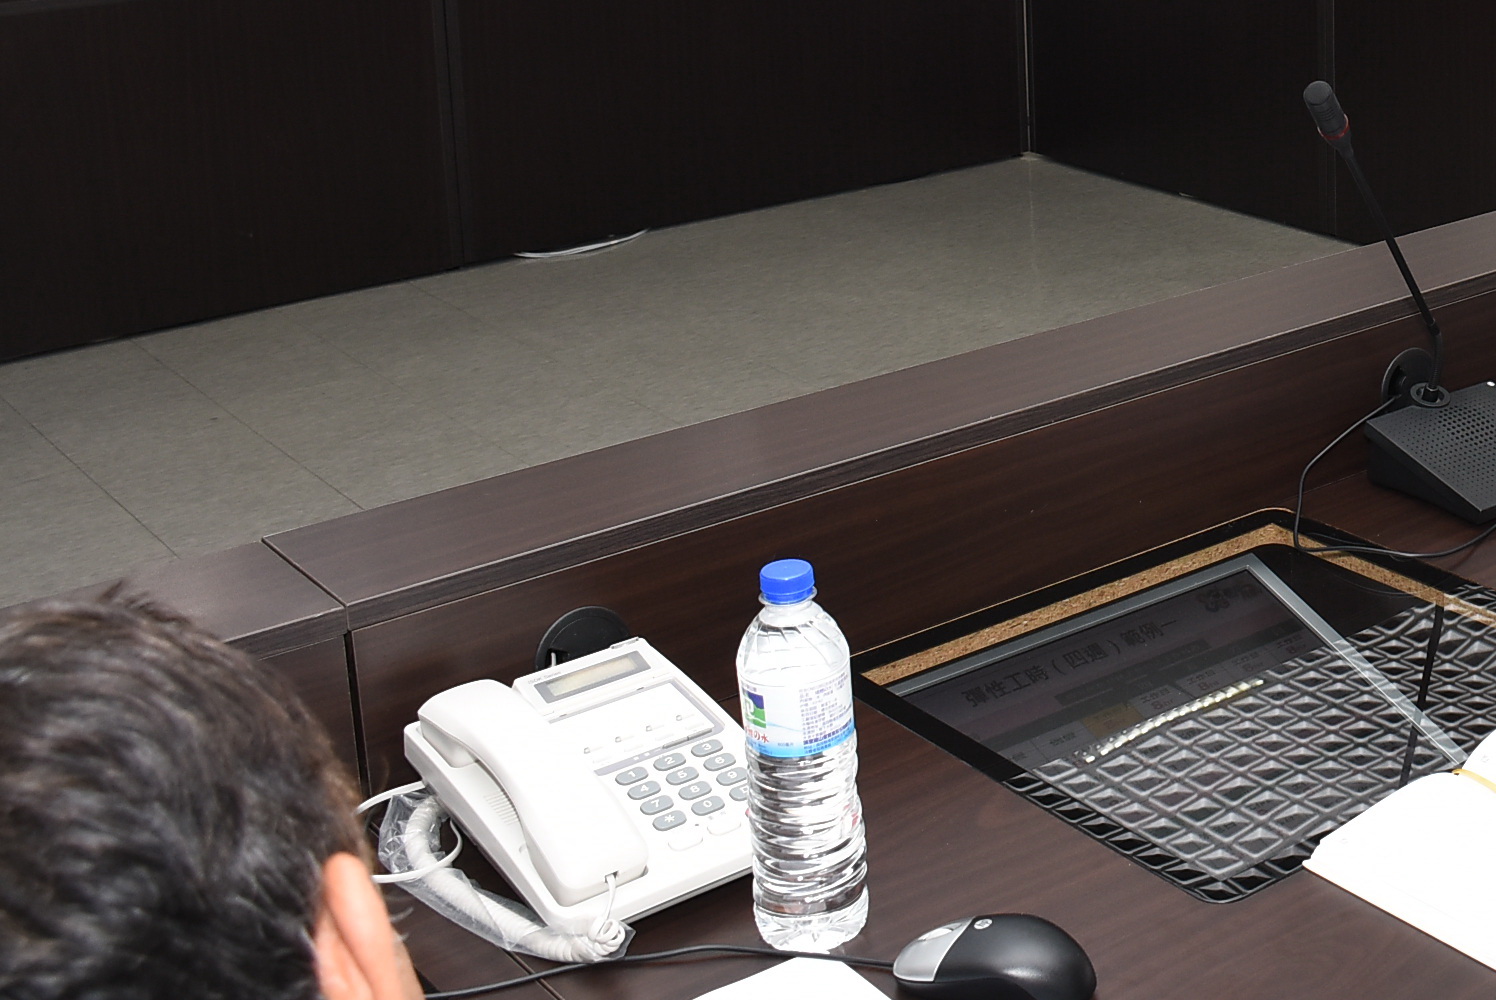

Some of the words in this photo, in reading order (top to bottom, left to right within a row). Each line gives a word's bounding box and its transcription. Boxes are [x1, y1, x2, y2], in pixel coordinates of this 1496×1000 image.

[665, 757, 675, 765] 2
[702, 743, 712, 751] 3
[677, 771, 688, 779] 5
[651, 800, 660, 808] 7
[690, 785, 700, 793] 8
[727, 771, 737, 779] 9
[703, 800, 713, 808] 0
